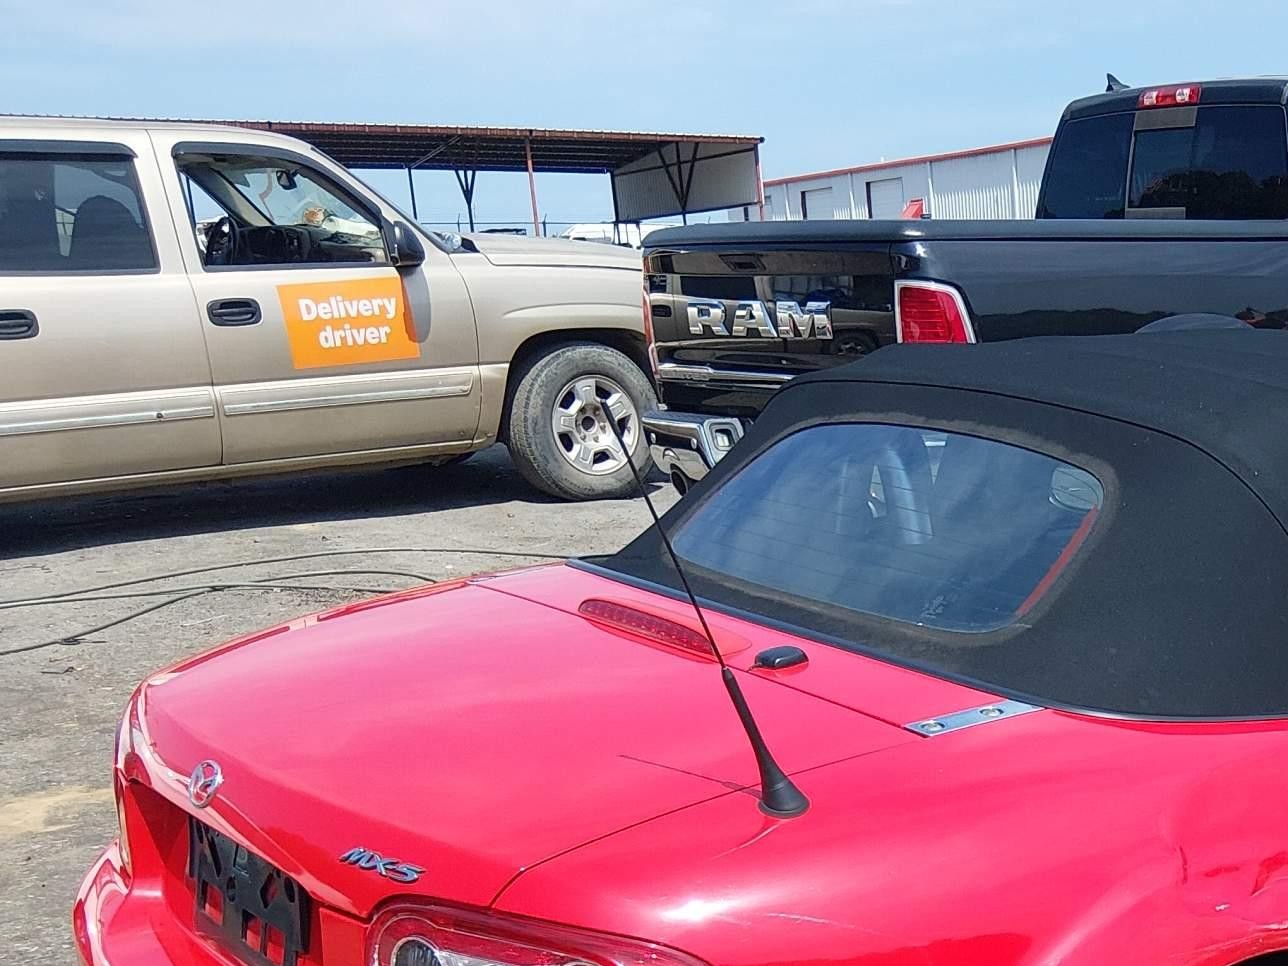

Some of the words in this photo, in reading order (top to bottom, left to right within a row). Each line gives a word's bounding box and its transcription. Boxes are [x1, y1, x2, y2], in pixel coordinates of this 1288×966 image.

[298, 296, 397, 321] Delivery
[688, 301, 833, 340] RAM
[319, 324, 391, 348] driver
[339, 847, 426, 882] MX-5
